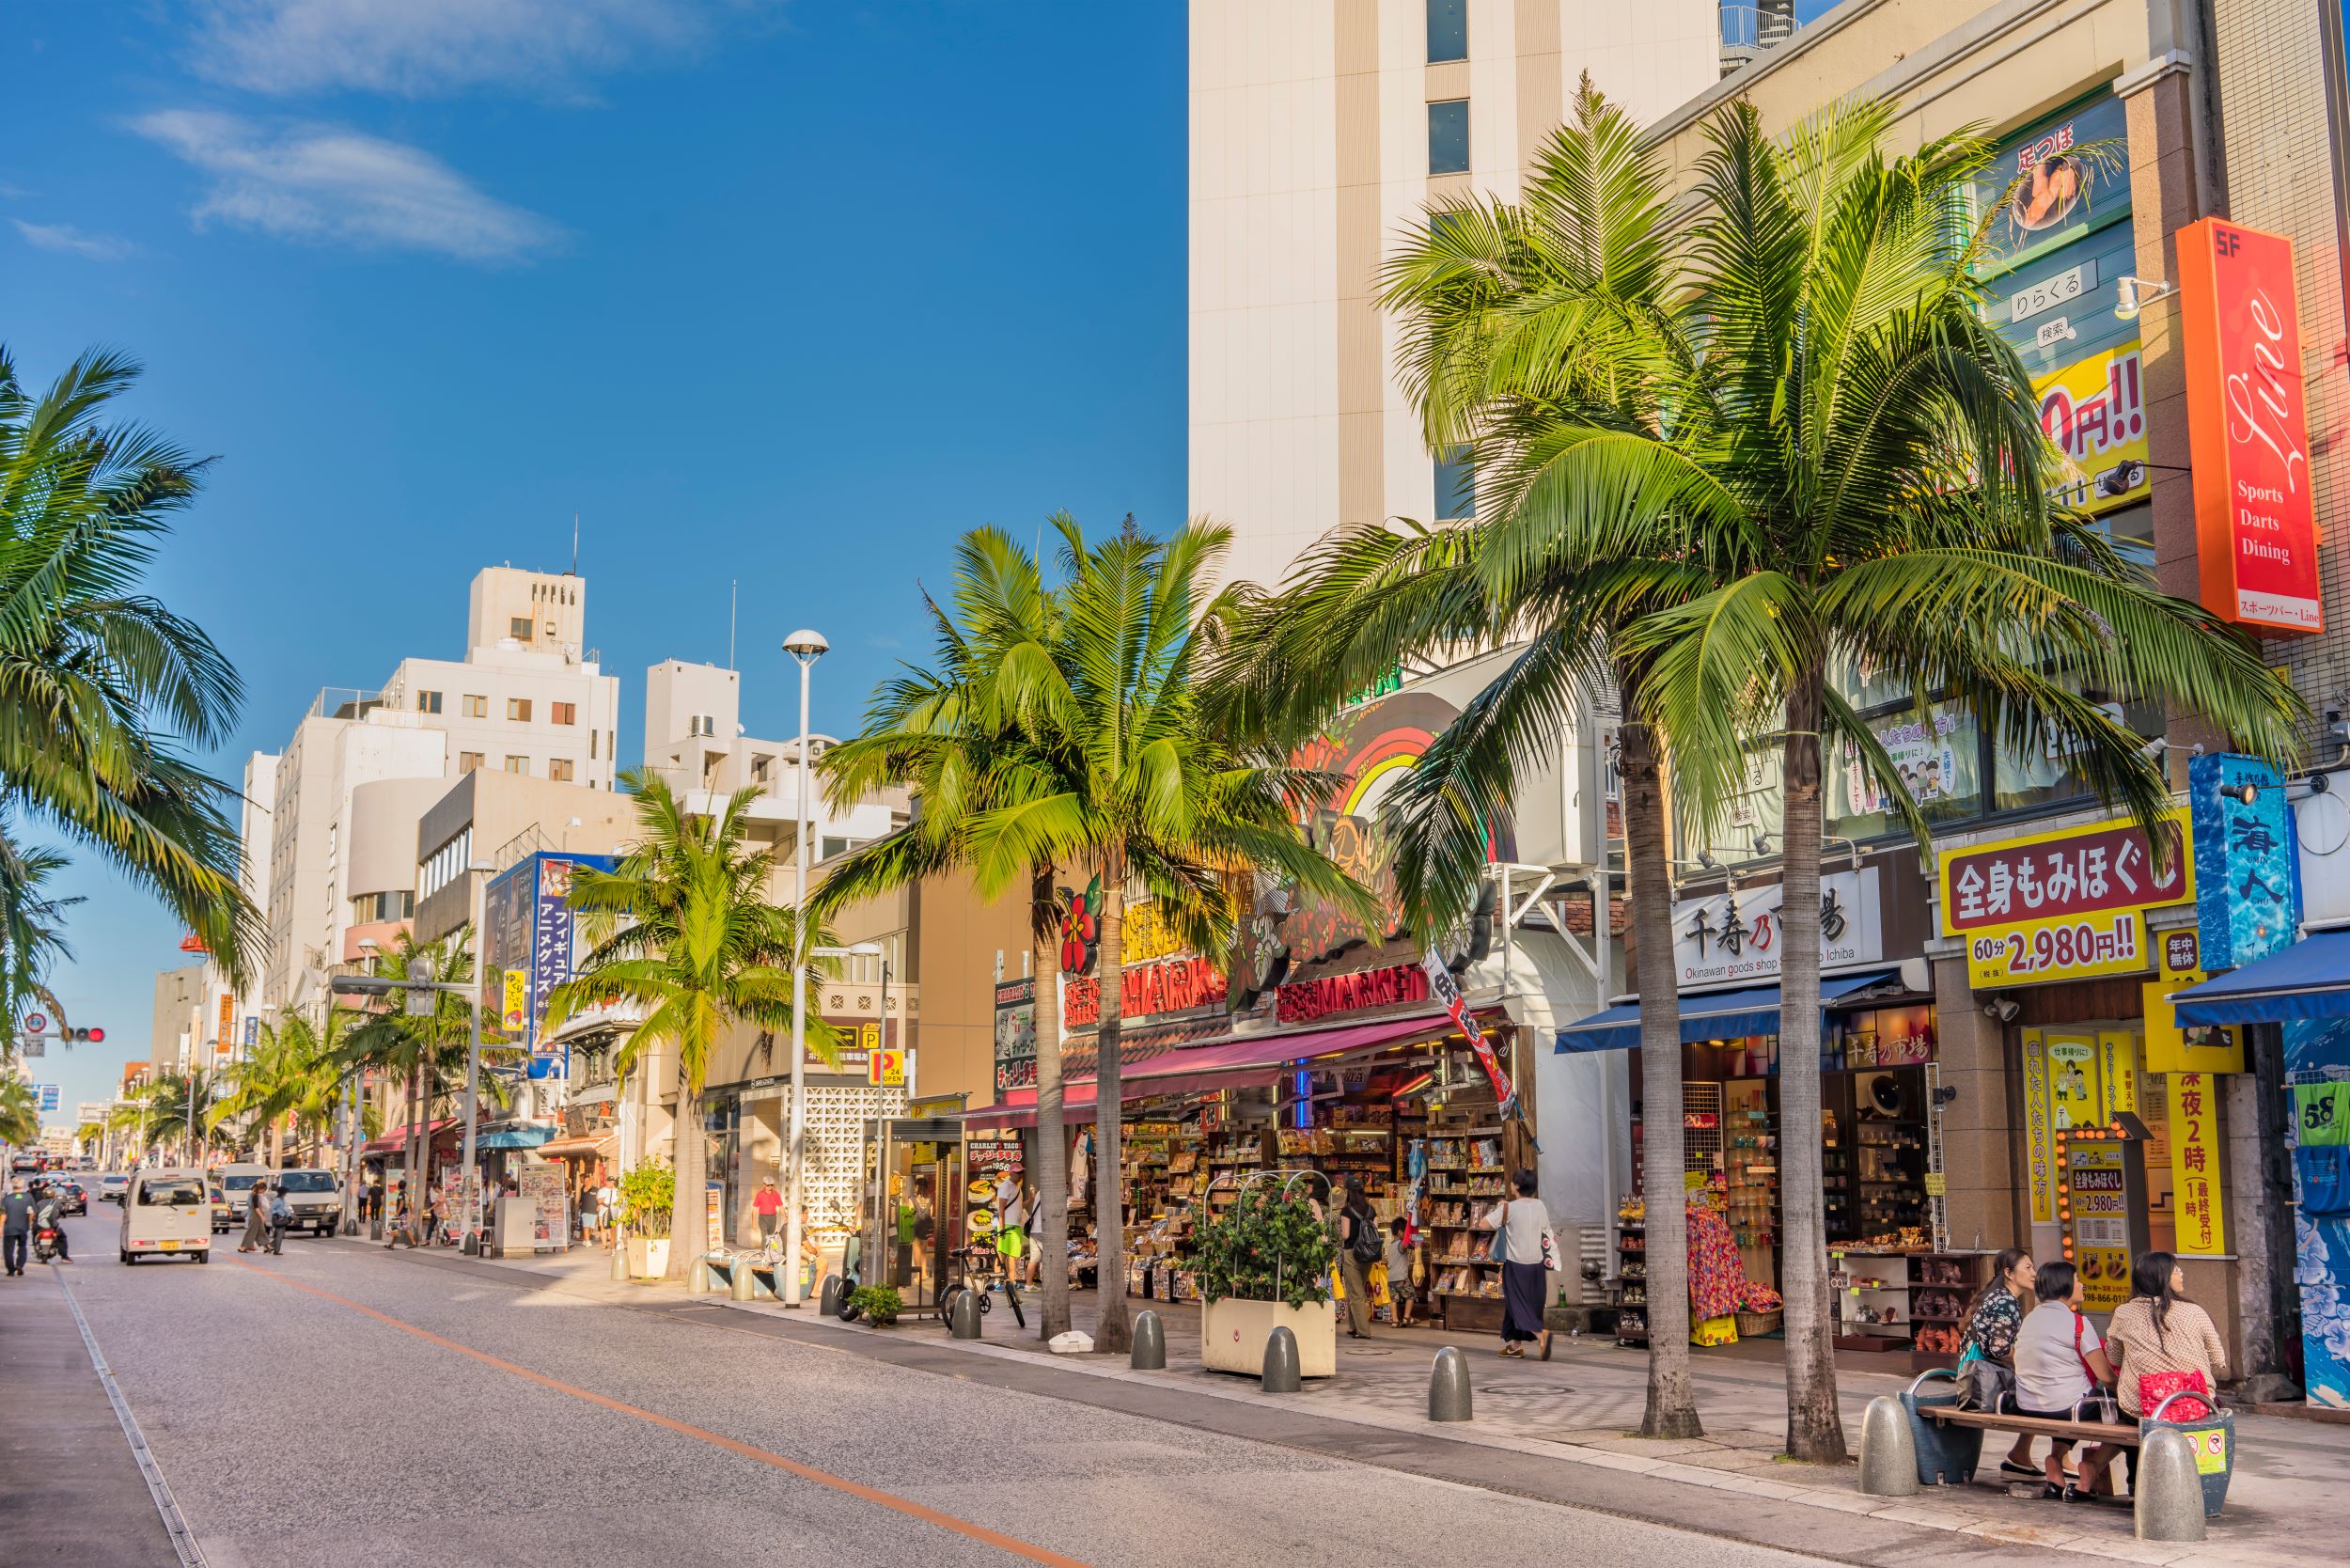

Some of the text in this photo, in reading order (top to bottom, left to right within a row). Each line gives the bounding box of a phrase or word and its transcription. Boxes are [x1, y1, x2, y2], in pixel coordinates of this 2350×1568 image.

[2017, 122, 2075, 173] 足つぼ
[2216, 230, 2240, 258] SF
[2016, 274, 2079, 315] りらくる
[2042, 322, 2064, 341] 検索
[2229, 288, 2304, 493] Line
[2238, 479, 2284, 503] Sports
[2240, 509, 2280, 531] Darts
[2242, 537, 2291, 566] Dining
[2248, 856, 2269, 865] UMIN
[2252, 898, 2270, 906] CHU
[537, 903, 555, 993] アニメグッズ
[553, 912, 568, 985] フィギュア
[2170, 938, 2194, 953] 年中
[2170, 952, 2195, 966] 無休
[1685, 948, 1855, 980] Okinawan goods shop Ichiba
[867, 1033, 875, 1046] P
[1847, 1034, 1929, 1065] 千寿乃市場
[873, 1053, 895, 1082] P
[2304, 1096, 2335, 1129] 58
[993, 1162, 1010, 1172] 1956
[2075, 1171, 2122, 1189] 全身もみほぐし
